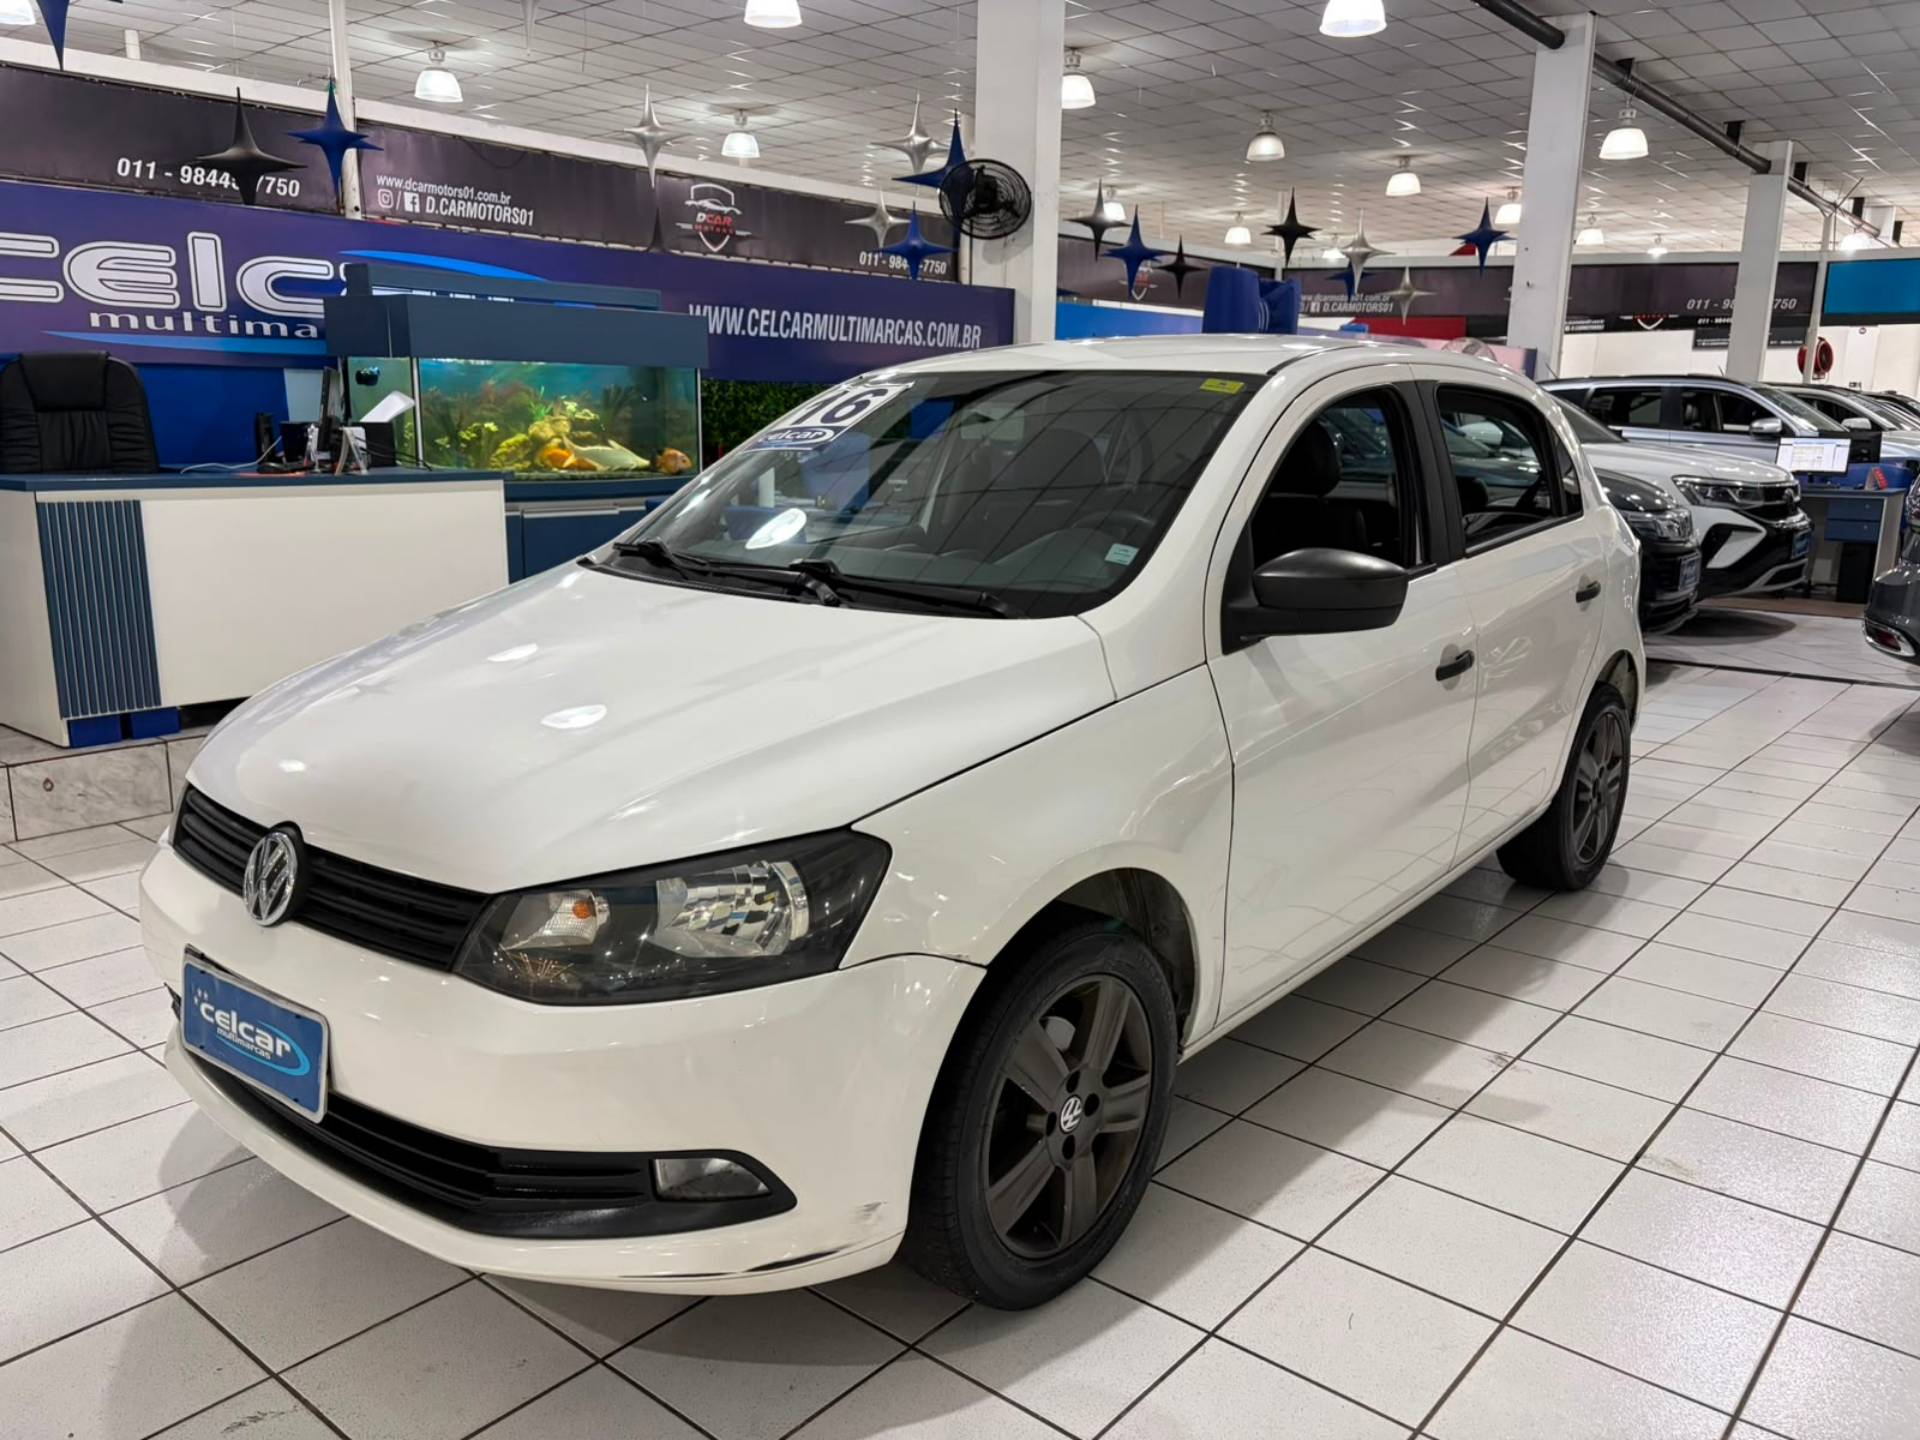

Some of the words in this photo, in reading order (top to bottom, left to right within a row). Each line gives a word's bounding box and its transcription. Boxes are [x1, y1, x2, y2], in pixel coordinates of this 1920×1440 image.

[116, 157, 156, 180] 011
[180, 165, 300, 197] 9844750
[376, 175, 511, 205] www.dcarmotors01.com.br
[425, 196, 534, 226] D.CARMOTORS01
[696, 212, 733, 225] DCAR
[859, 251, 879, 266] 011
[889, 255, 947, 275] 984-7750
[1686, 298, 1710, 310] 011
[790, 389, 889, 426] 16
[200, 1001, 291, 1058] celcar
[216, 1026, 272, 1060] multimarcas
